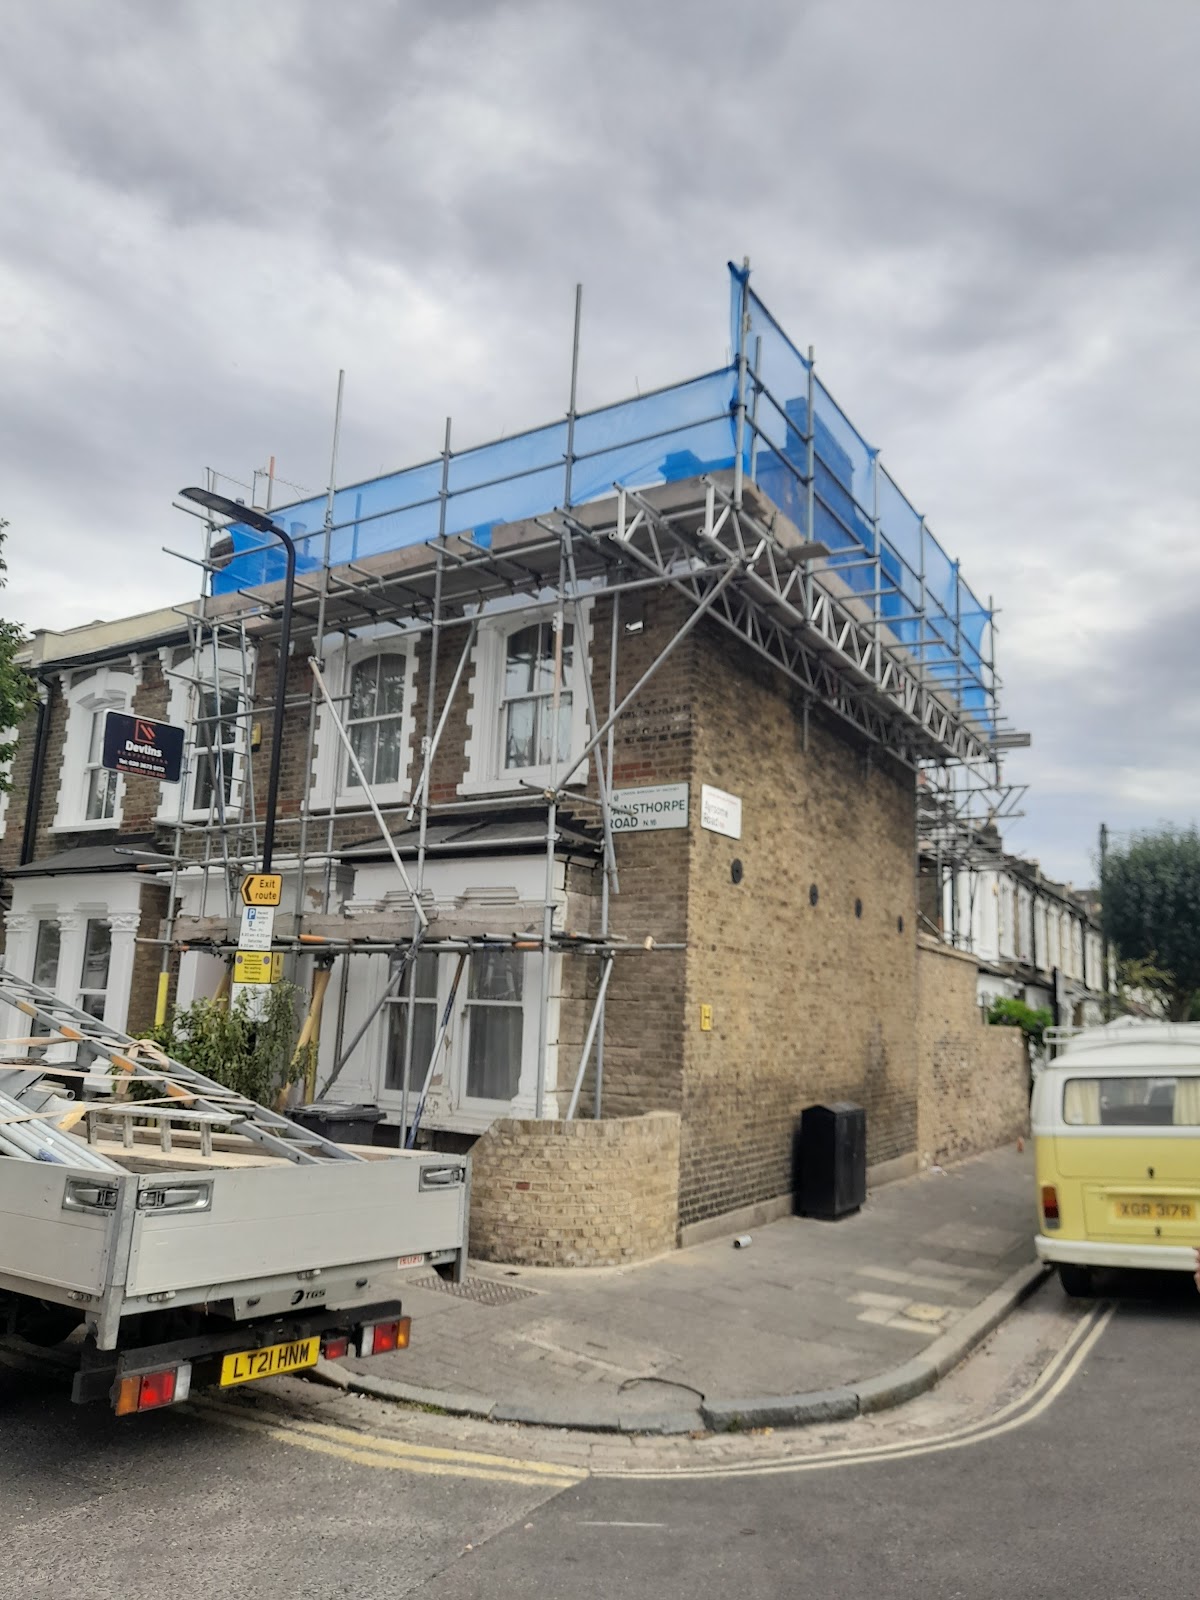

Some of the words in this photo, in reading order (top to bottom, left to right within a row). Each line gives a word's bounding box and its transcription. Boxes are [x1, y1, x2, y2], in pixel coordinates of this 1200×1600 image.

[125, 740, 162, 757] Devlins
[259, 879, 275, 889] Exit
[255, 890, 277, 900] route
[305, 1289, 326, 1300] TGS
[233, 1349, 273, 1379] LT21
[277, 1343, 310, 1370] HNM
